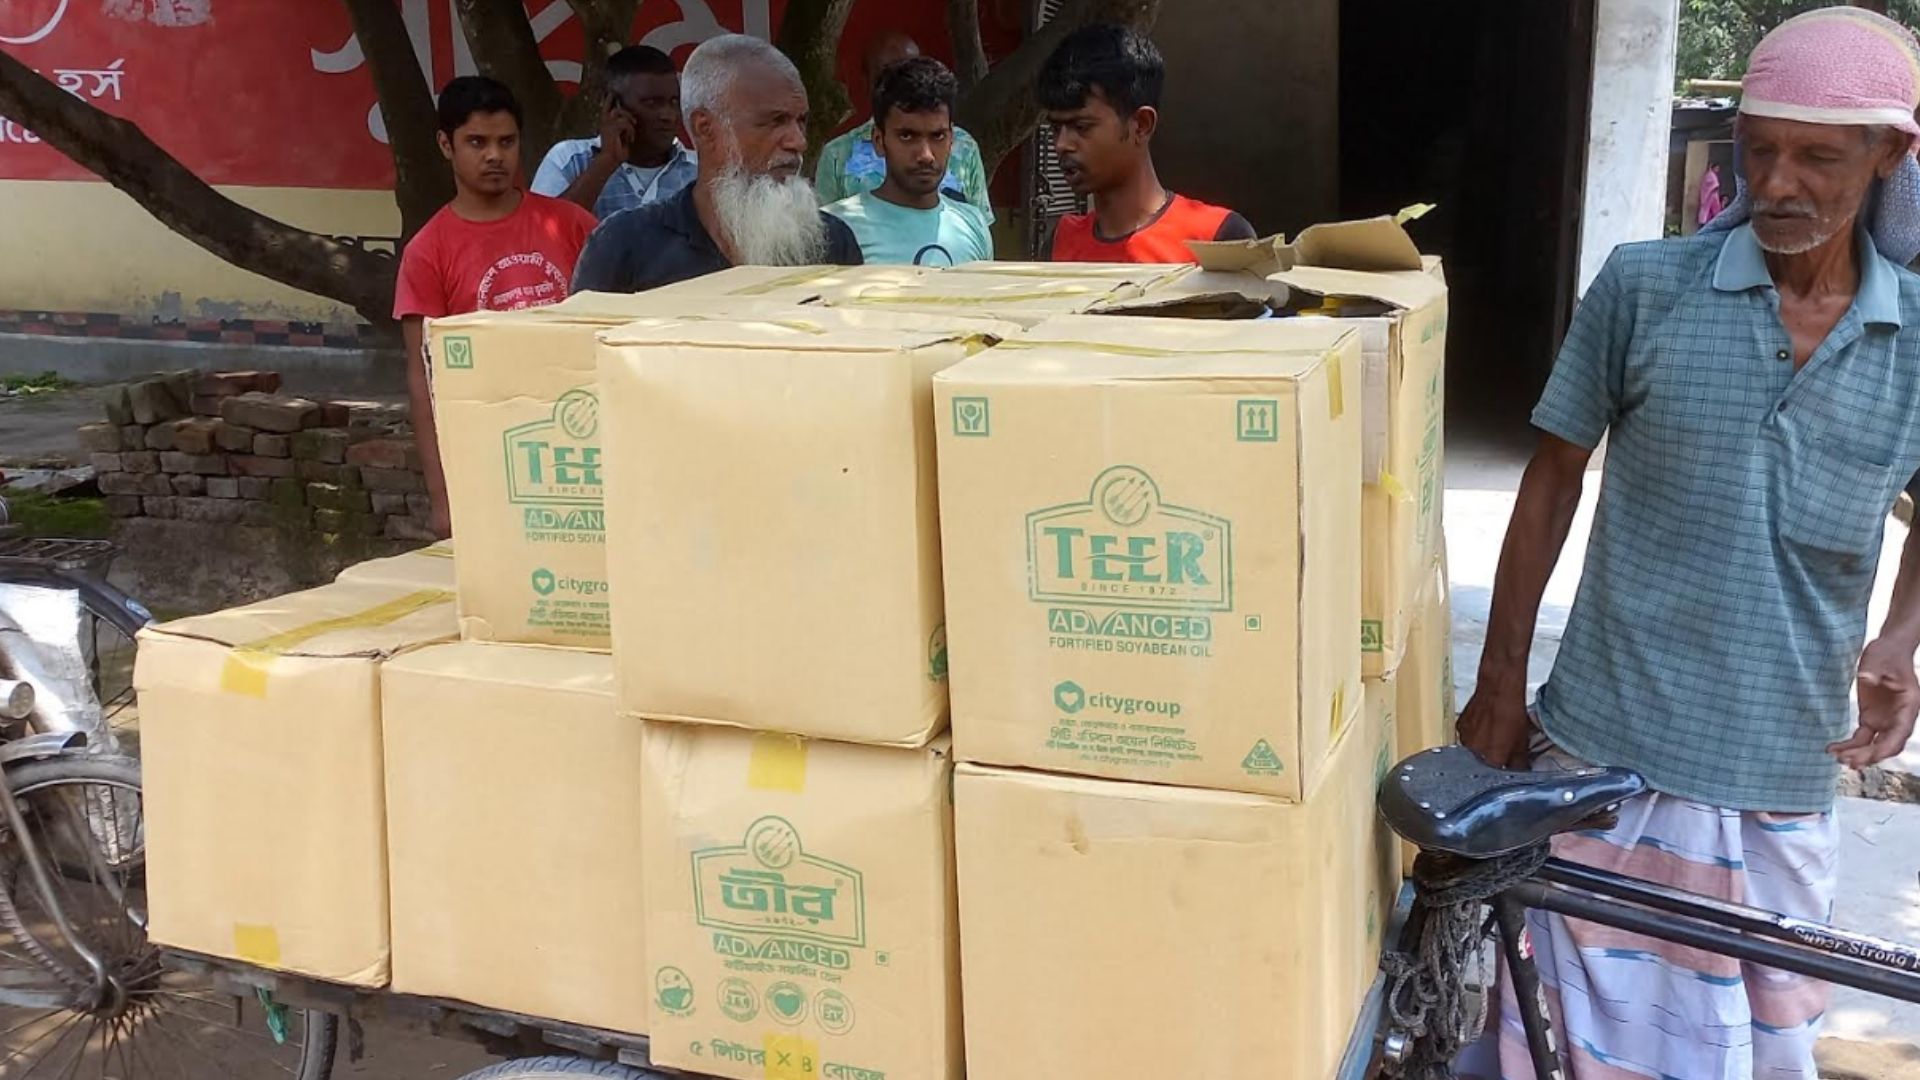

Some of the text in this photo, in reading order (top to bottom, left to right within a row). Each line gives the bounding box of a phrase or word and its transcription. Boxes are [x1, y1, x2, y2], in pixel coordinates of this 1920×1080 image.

[517, 441, 603, 484] TEE
[525, 508, 604, 530] ADVAN
[577, 532, 606, 544] SOYA
[1043, 527, 1211, 585] TEER
[558, 577, 609, 595] citygro
[1081, 582, 1177, 596] SINCE 1972
[1049, 609, 1212, 641] ADVANCED
[1049, 636, 1212, 658] FORTIFIED SOYABEAN OIL
[1089, 692, 1181, 718] citygroup
[719, 868, 837, 925] তীর
[714, 933, 850, 970] ADVANCED
